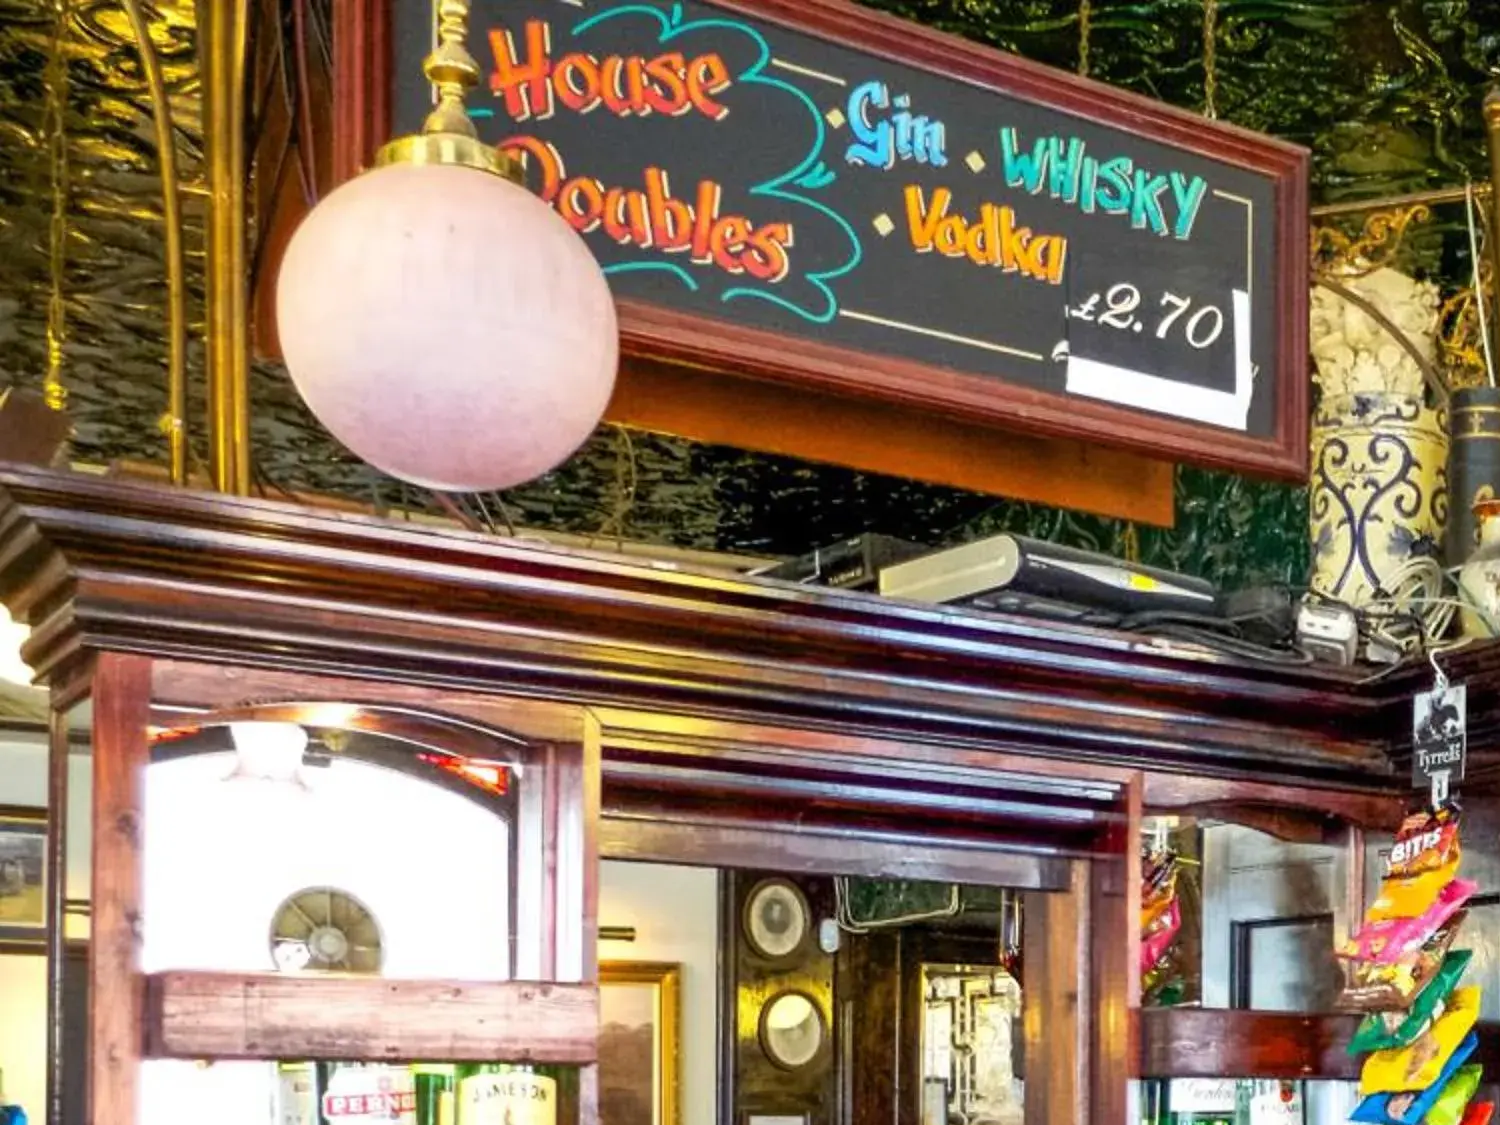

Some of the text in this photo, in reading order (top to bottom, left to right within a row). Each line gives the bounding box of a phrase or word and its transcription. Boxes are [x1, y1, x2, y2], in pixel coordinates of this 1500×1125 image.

[488, 17, 732, 122] House
[497, 134, 796, 284] Doubles
[846, 79, 1208, 241] Gin WHISKY
[902, 183, 1068, 285] Vodka
[1070, 282, 1224, 349] £2.70
